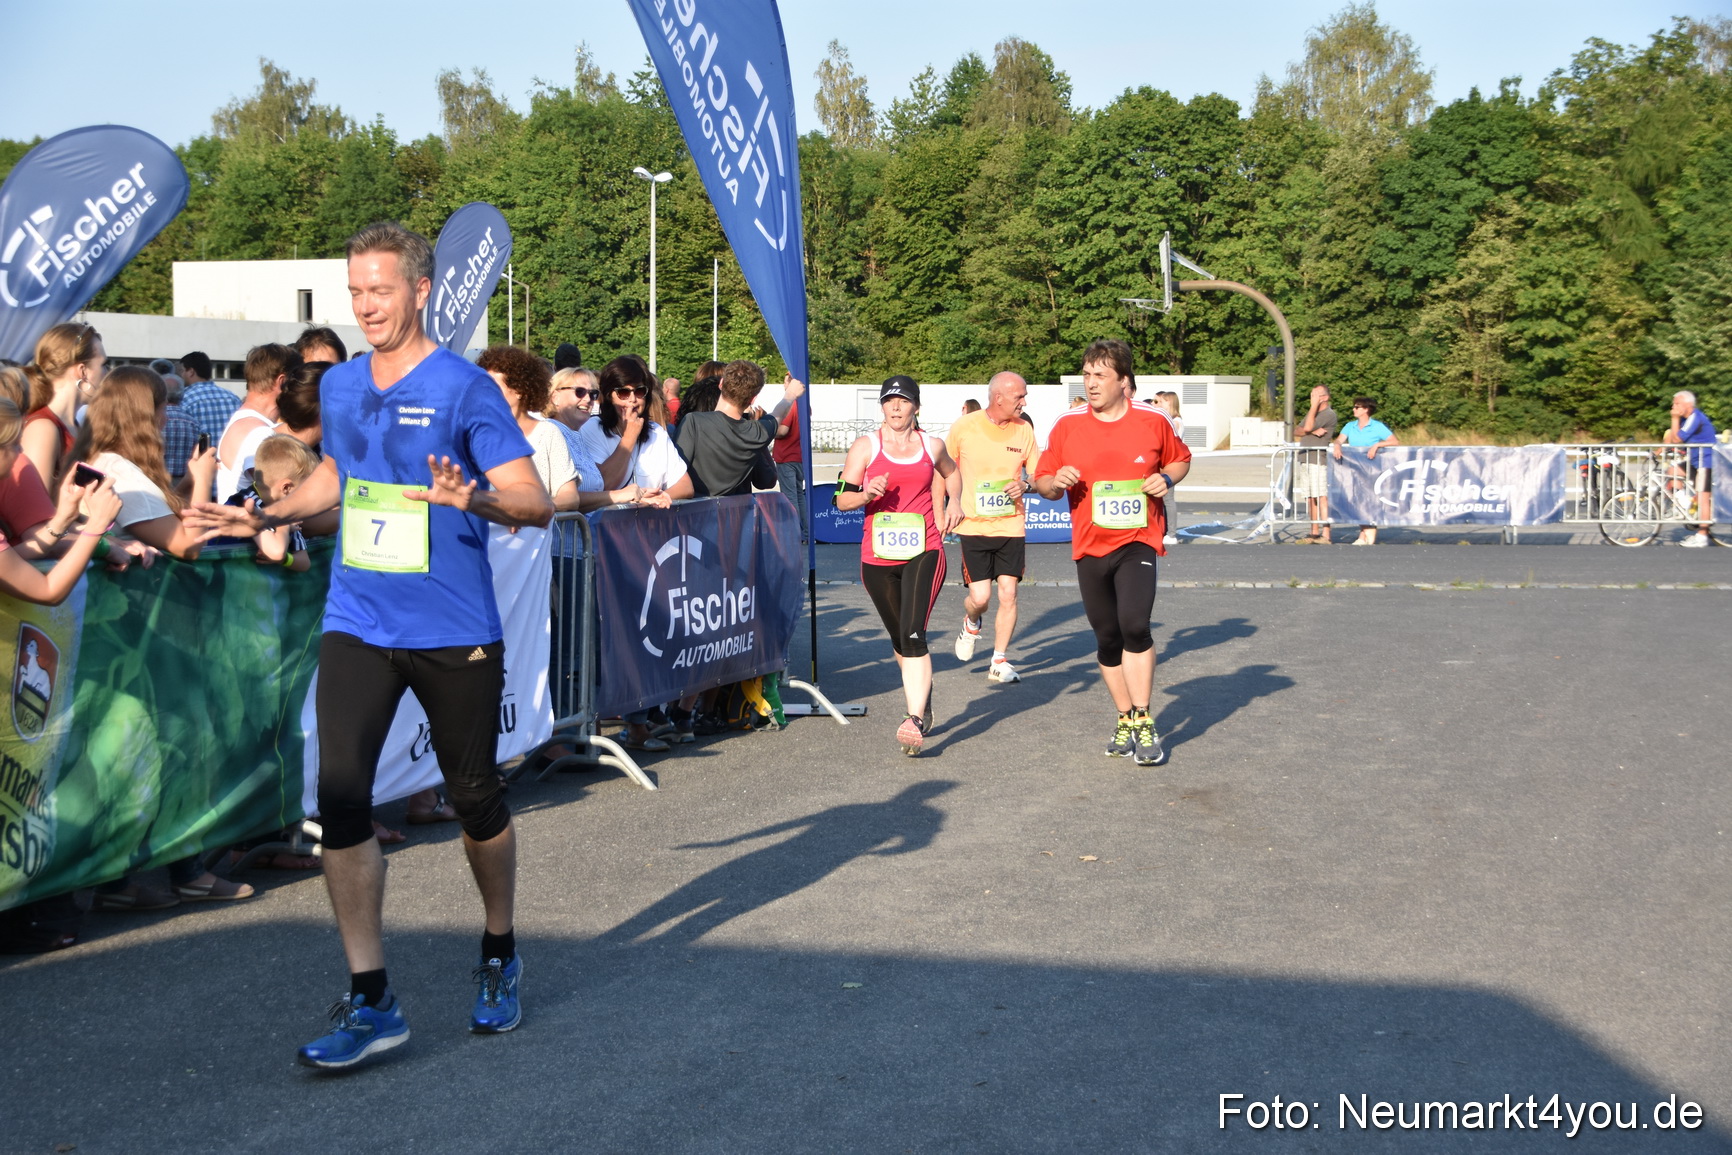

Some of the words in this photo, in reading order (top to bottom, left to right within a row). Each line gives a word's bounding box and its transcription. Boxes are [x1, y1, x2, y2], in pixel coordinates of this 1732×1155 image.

[26, 161, 146, 288] Fischer
[62, 191, 157, 288] AUTOMOBILE
[445, 226, 494, 325] Fischer
[460, 245, 499, 324] AUTOMOBILE
[399, 406, 423, 414] Christian
[423, 407, 436, 415] Lenz
[399, 417, 421, 425] Allianz
[1399, 479, 1516, 501] Fischer
[978, 494, 1014, 507] 1462
[1098, 499, 1141, 516] 1369
[1409, 502, 1505, 513] AUTOMOBILE
[815, 509, 829, 518] und
[1025, 509, 1071, 522] ische
[371, 518, 387, 546] 7
[878, 531, 919, 547] 1368
[468, 653, 487, 661] adidas
[672, 631, 754, 669] AUTOMOBILE
